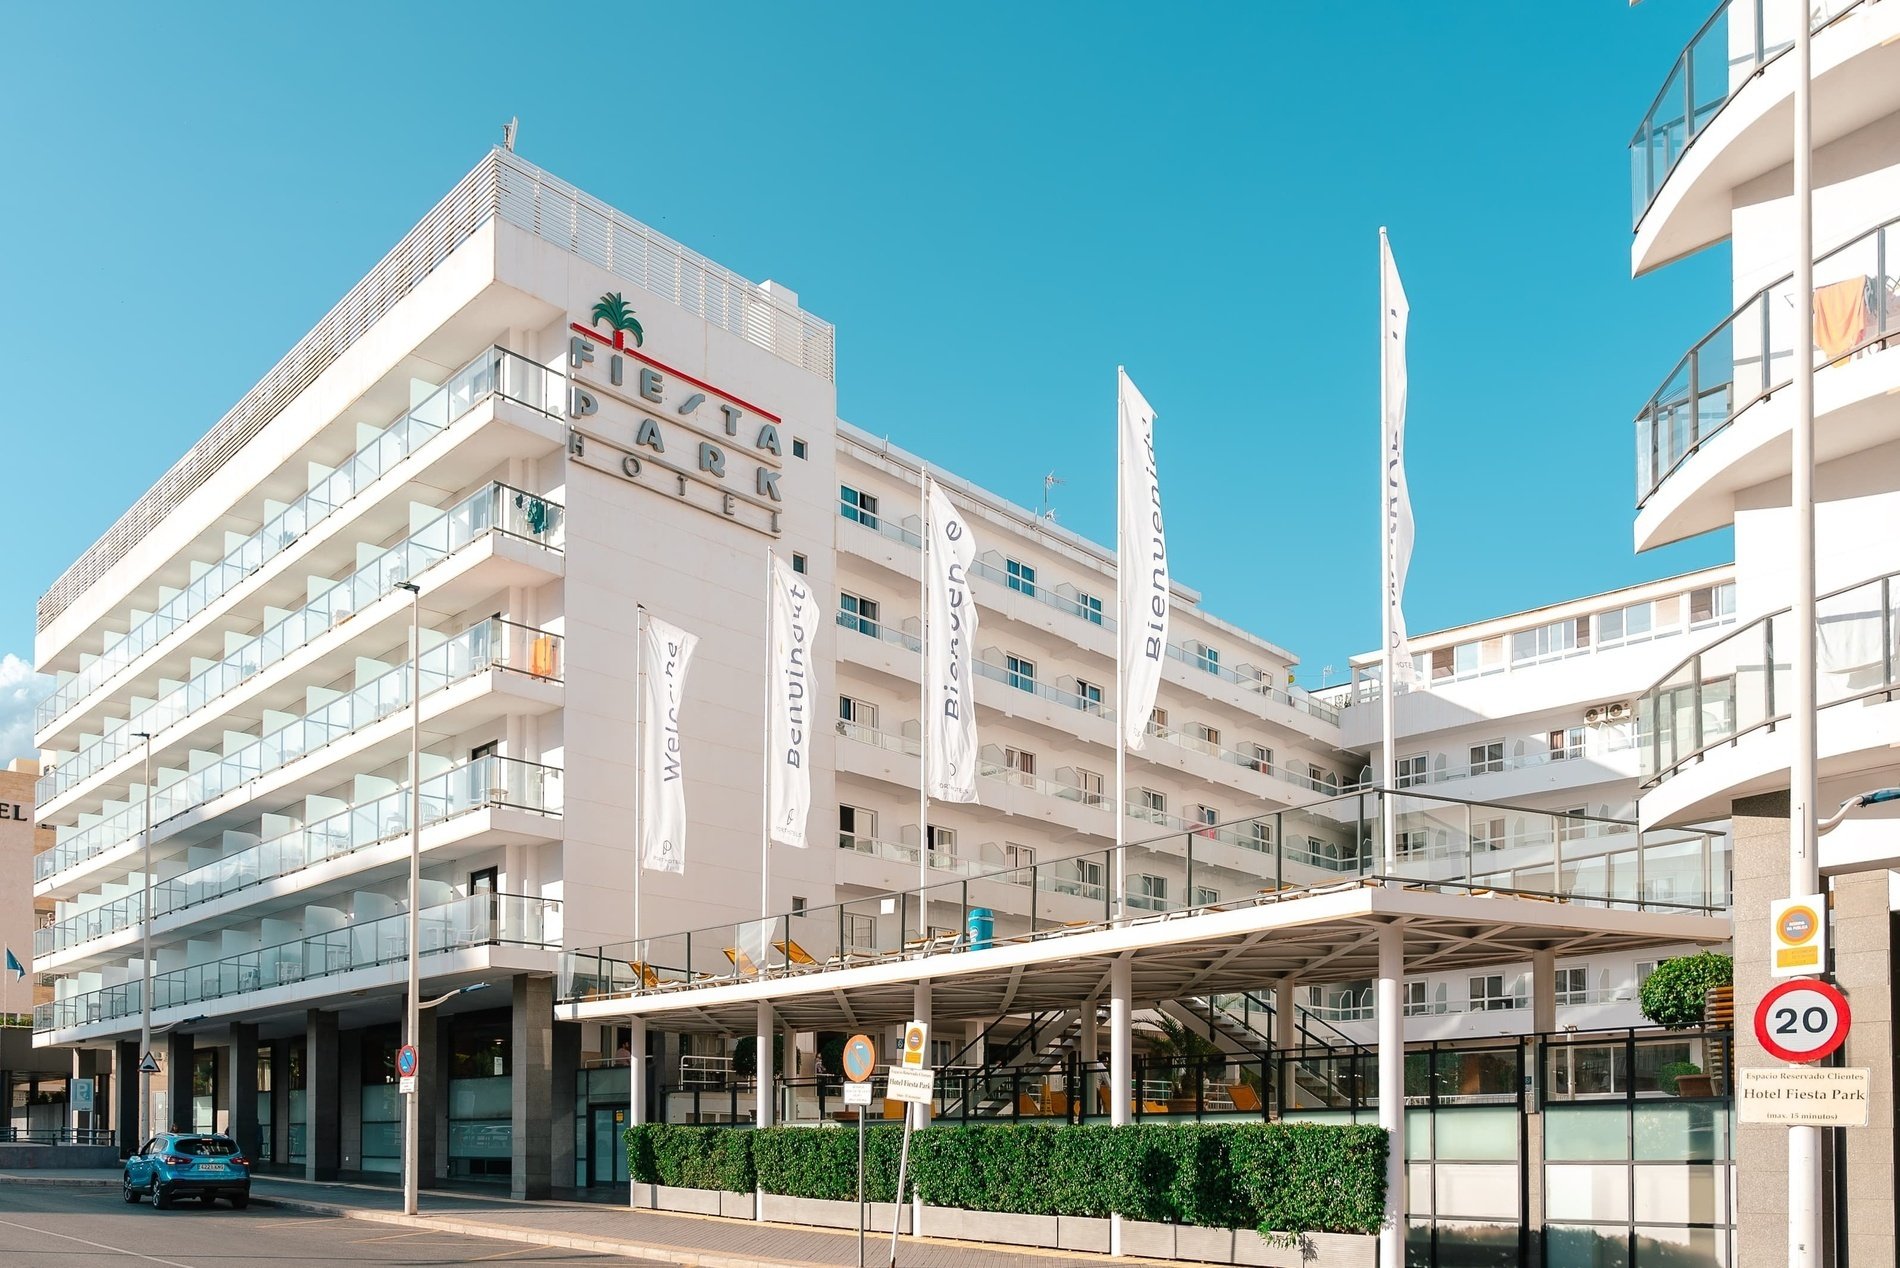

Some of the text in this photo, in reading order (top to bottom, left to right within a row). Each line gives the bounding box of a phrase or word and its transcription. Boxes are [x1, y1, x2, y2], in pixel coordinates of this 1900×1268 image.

[571, 336, 782, 456] FIESTA
[570, 386, 782, 502] PARK
[569, 433, 781, 533] HOTEL
[1775, 1007, 1828, 1035] 20
[1746, 1072, 1864, 1081] Espacio Reservado Clientes
[1744, 1088, 1865, 1100] Hotel Fiesta Park
[1766, 1112, 1788, 1120] (max.
